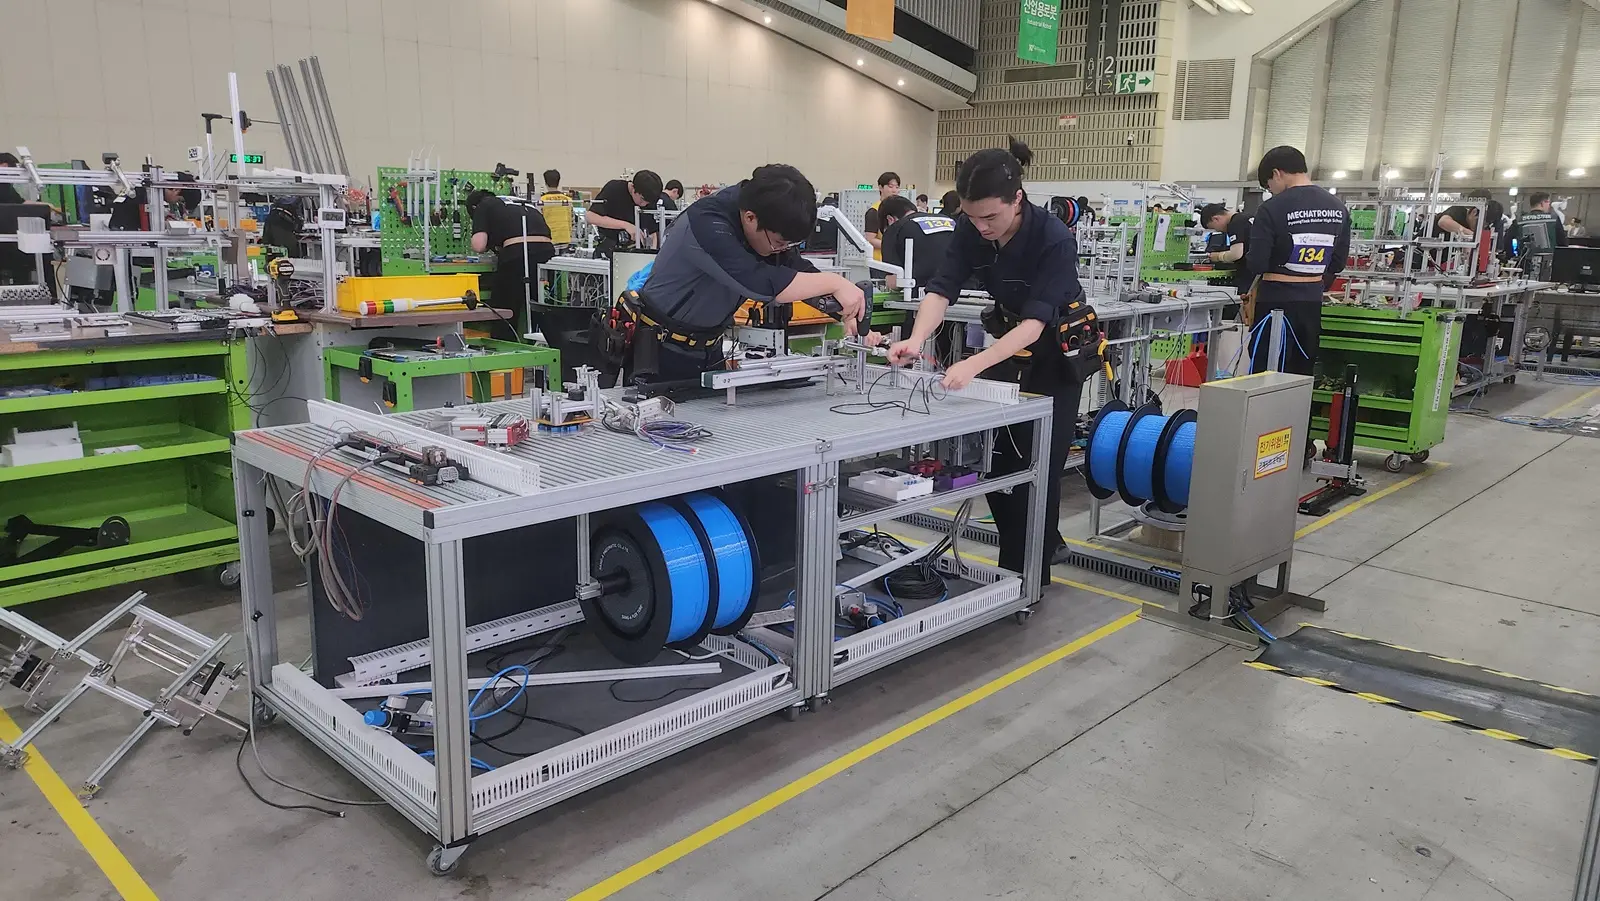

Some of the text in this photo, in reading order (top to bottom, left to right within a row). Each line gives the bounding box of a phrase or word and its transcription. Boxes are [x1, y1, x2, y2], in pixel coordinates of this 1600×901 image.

[1024, 0, 1057, 20] 산업용로봇
[1104, 56, 1114, 74] 2
[1287, 209, 1343, 221] MECHATRONICS
[1298, 247, 1325, 263] 134
